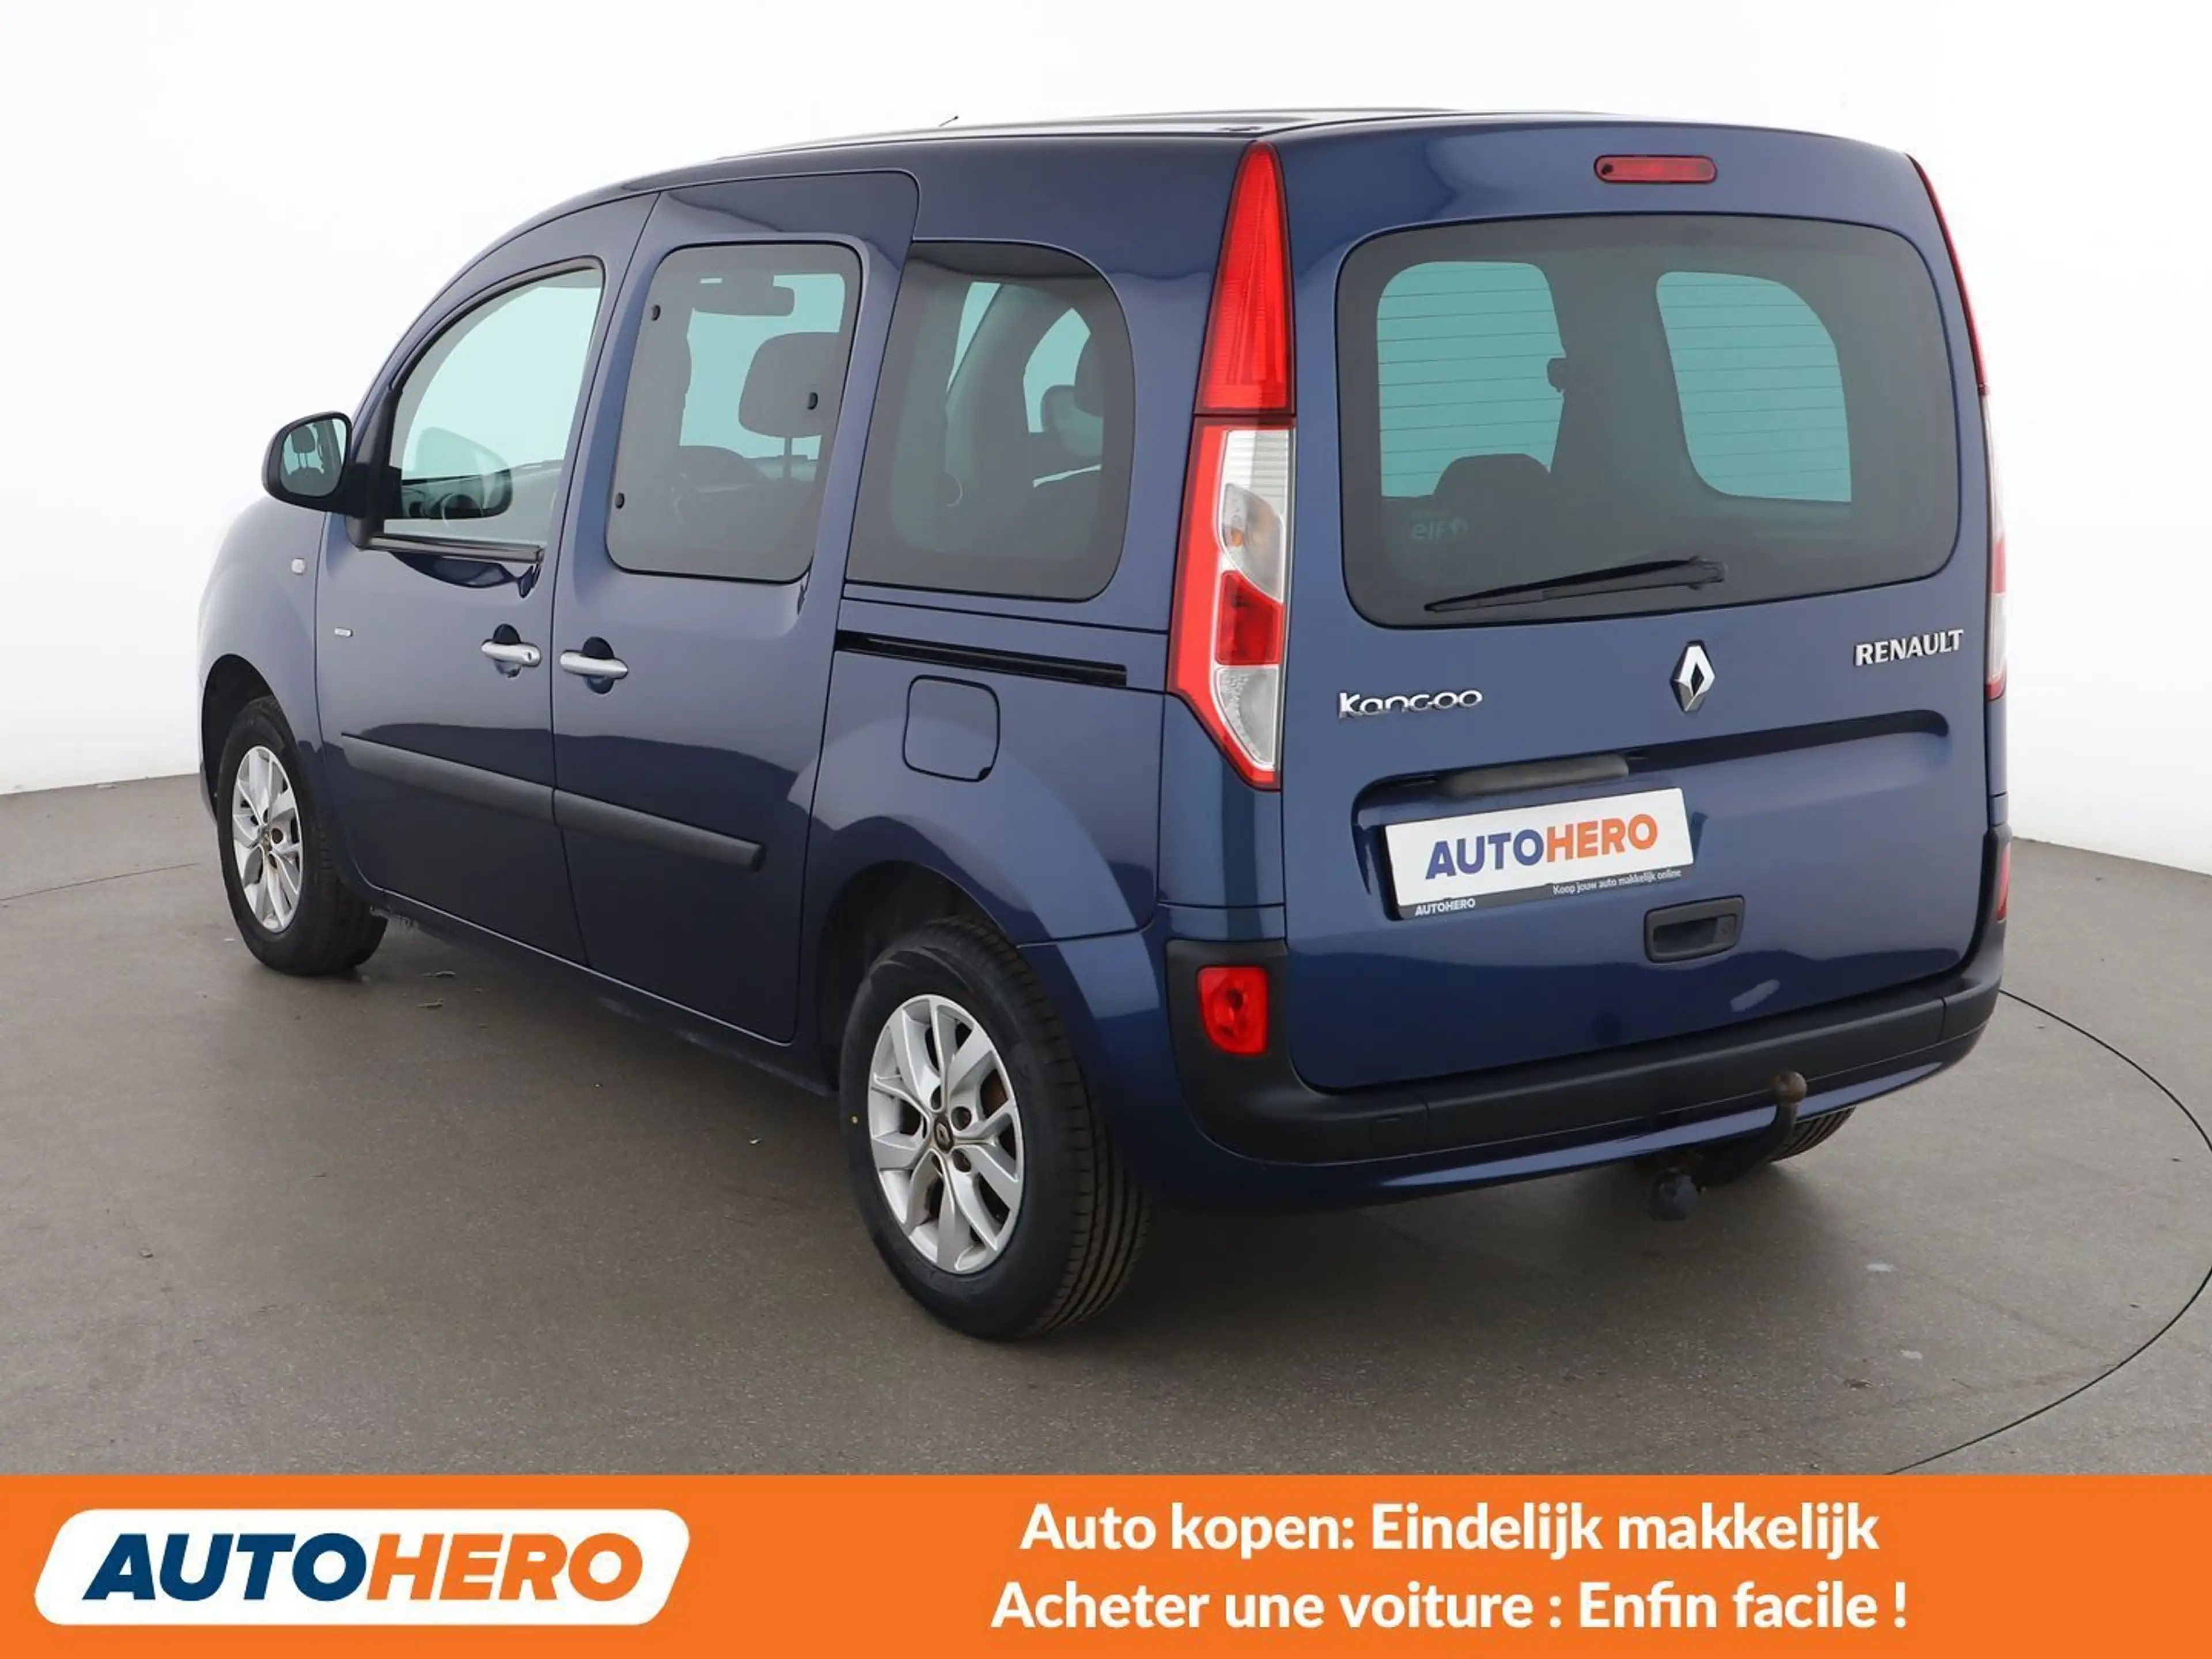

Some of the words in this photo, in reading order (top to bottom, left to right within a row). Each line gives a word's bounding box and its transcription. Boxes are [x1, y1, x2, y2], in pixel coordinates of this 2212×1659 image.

[1854, 628, 1964, 666] RENAULT
[1426, 813, 1658, 880] AUTOHERO
[1553, 884, 1575, 895] Koop
[1576, 881, 1597, 893] jouw
[1599, 877, 1617, 888] auto
[1619, 871, 1656, 884] makkelijk
[1657, 869, 1681, 880] online
[1414, 898, 1476, 916] AUTOHERO
